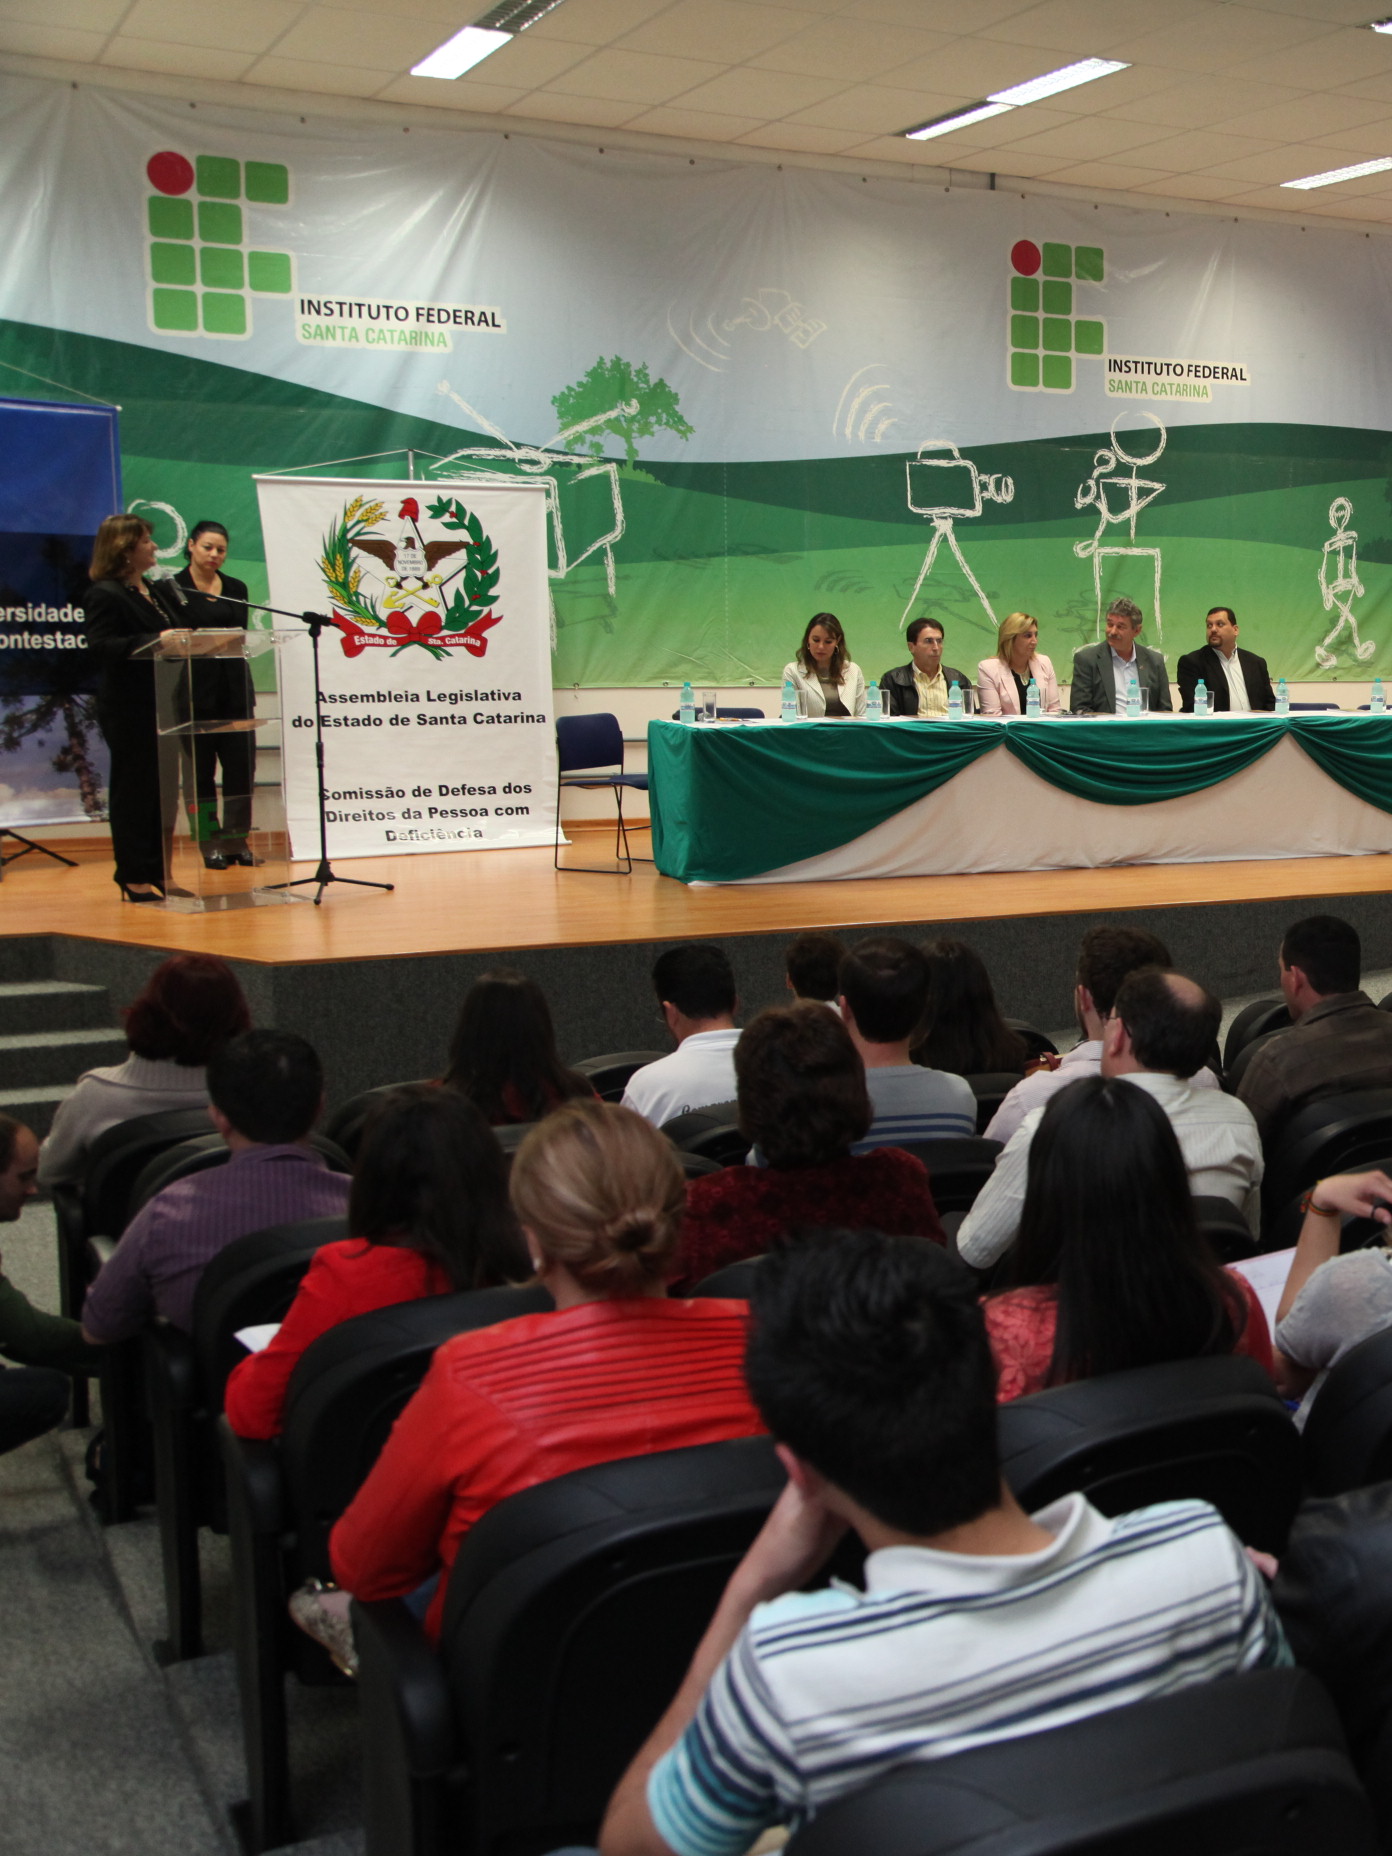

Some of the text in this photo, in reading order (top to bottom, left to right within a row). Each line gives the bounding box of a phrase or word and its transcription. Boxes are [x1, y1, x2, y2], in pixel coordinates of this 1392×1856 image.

[300, 299, 502, 329] INSTITUTO FEDERAL
[302, 323, 448, 348] SANTA CATARINA
[1108, 358, 1248, 382] INSTITUTO FEDERAL
[1108, 378, 1209, 399] SANTA CATARINA
[354, 635, 481, 647] Estado de Sta. Catarina
[316, 689, 522, 705] Assembleia Legislativa
[292, 711, 547, 728] do Estado de Santa Catarina
[320, 782, 532, 801] Comissão de Defesa dos
[325, 804, 530, 824] Direitos da Pessoa com
[385, 827, 483, 842] Deficiência
